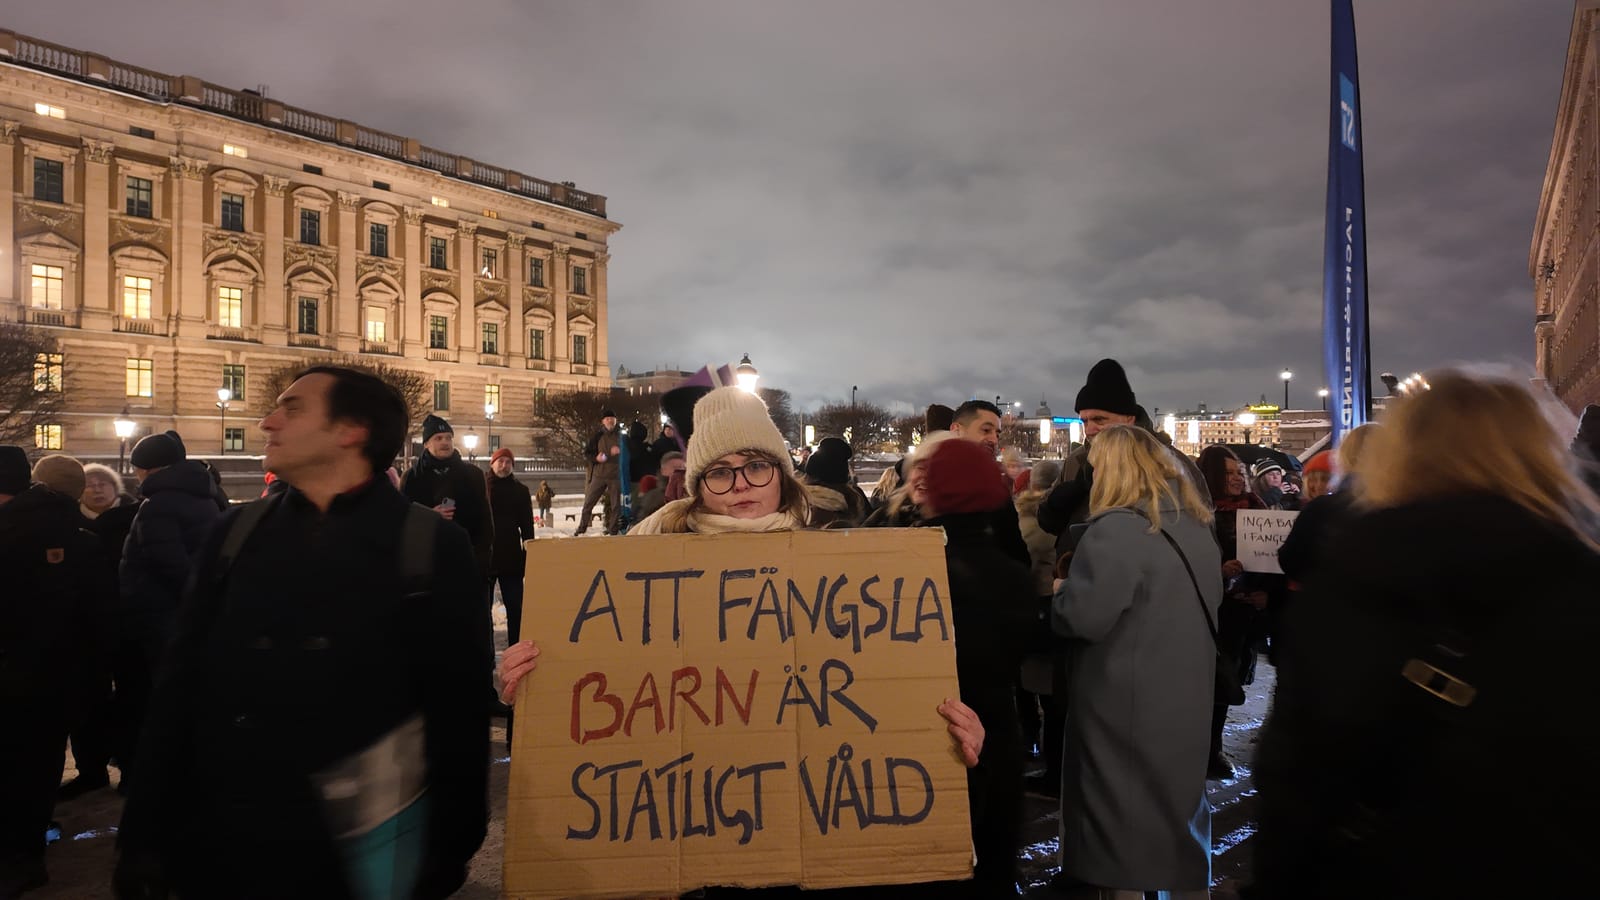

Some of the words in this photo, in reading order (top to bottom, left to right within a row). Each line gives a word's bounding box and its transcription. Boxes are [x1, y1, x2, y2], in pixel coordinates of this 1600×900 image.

[1243, 516, 1272, 532] INGA
[1276, 518, 1293, 528] BA
[568, 569, 704, 646] ATT
[718, 566, 949, 653] FÄNGSLA
[570, 665, 760, 745] BARN
[776, 659, 878, 734] ÄR
[566, 752, 786, 845] STATLIGT
[799, 743, 934, 836] VÅLD
